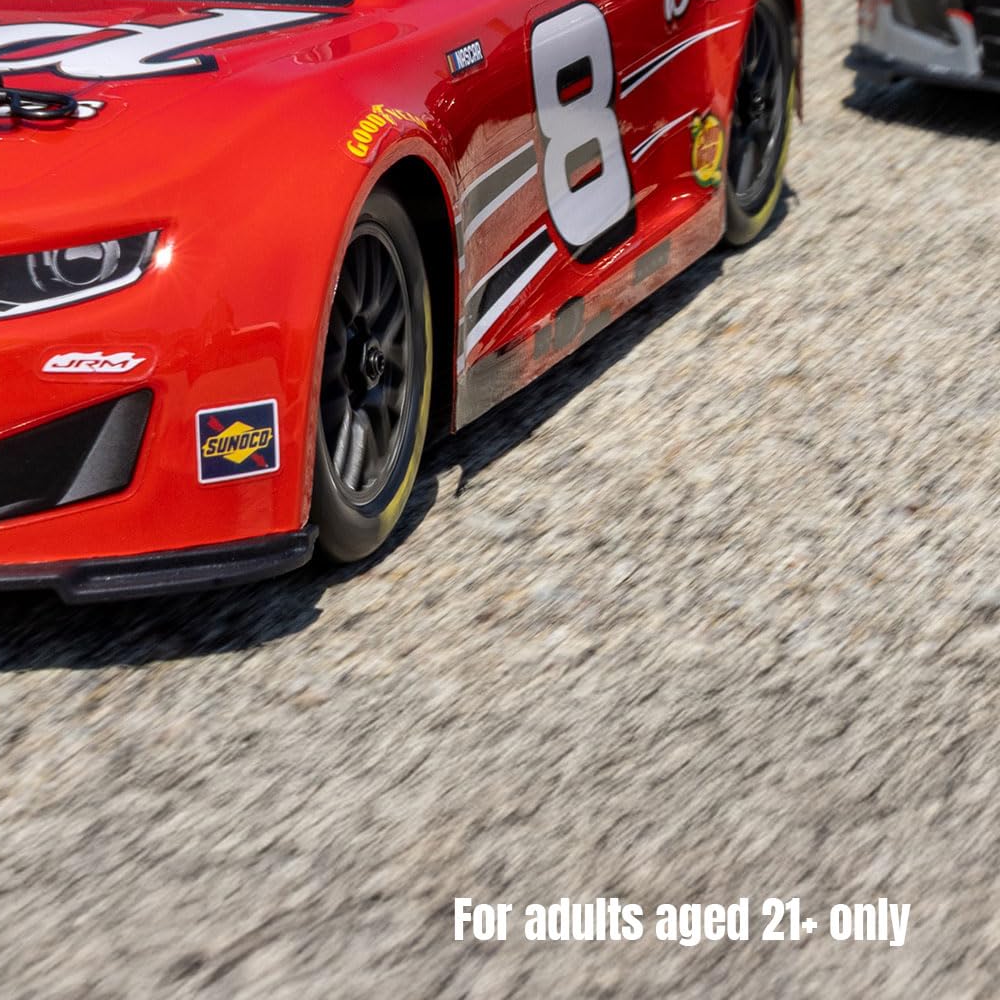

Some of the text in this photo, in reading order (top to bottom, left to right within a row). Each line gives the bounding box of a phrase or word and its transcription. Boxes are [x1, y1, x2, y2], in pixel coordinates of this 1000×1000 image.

[455, 41, 483, 70] NASCAR
[530, 3, 632, 247] 8
[52, 359, 130, 368] JRM
[206, 430, 270, 454] SUNOCO
